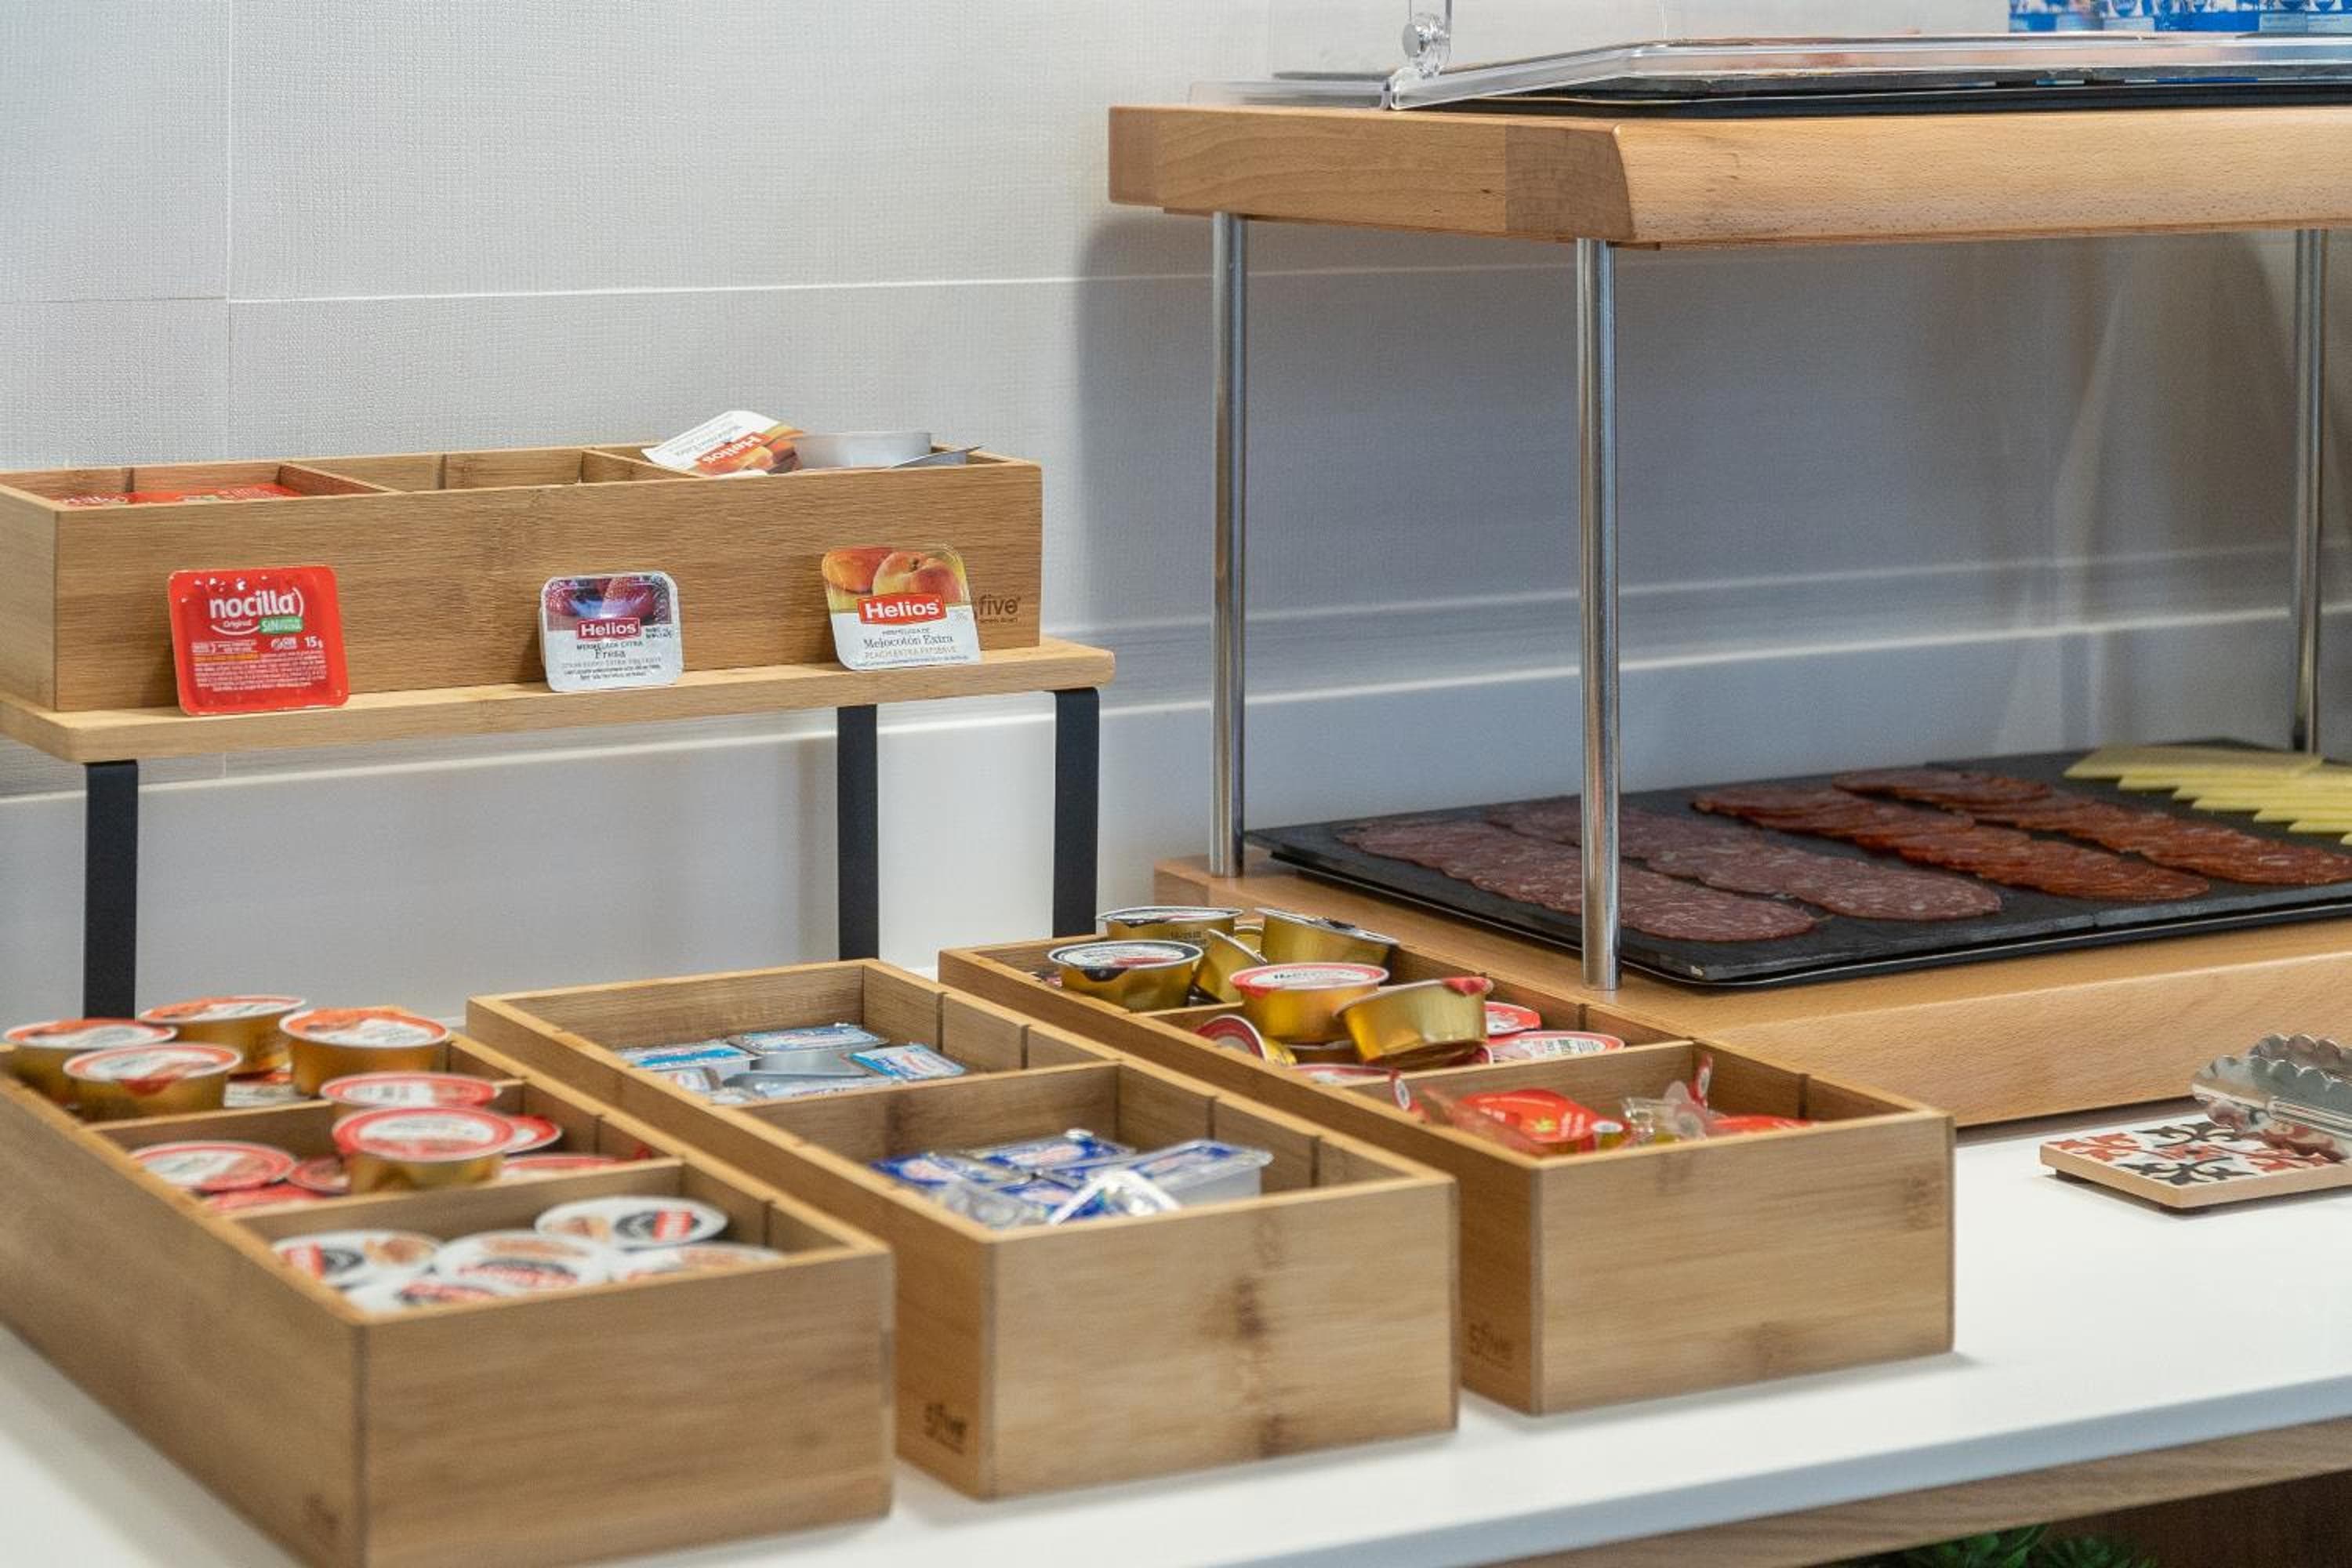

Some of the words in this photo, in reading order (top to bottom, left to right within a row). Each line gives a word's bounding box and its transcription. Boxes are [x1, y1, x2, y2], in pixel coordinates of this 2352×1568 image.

[209, 590, 296, 619] nocilla
[865, 601, 940, 620] Helios
[580, 621, 637, 637] Helios
[923, 634, 954, 645] Extra
